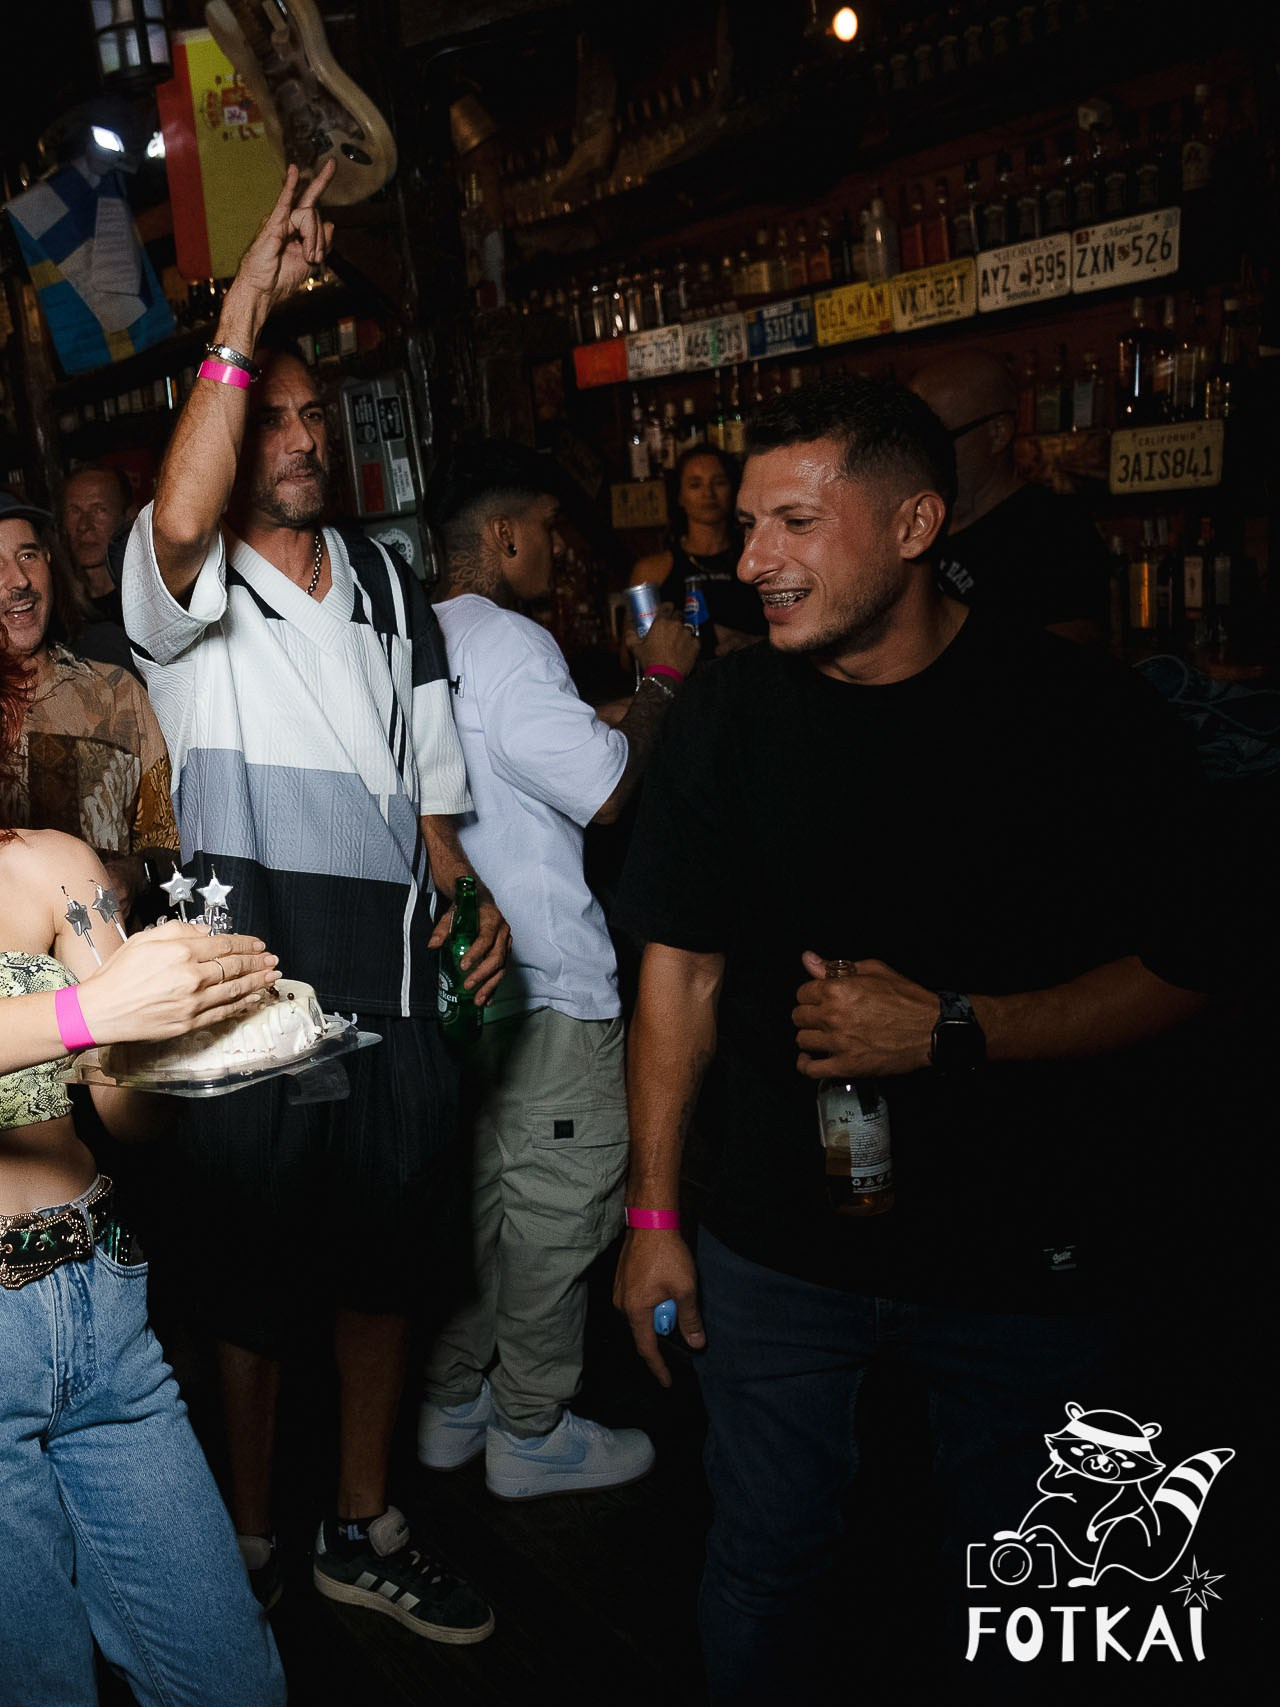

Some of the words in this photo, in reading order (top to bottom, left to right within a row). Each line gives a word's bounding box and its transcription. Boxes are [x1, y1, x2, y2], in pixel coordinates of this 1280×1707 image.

[1075, 240, 1116, 279] ZXN
[1131, 230, 1171, 267] 526
[981, 264, 1011, 297] AYZ
[1118, 445, 1214, 483] 3AIS841
